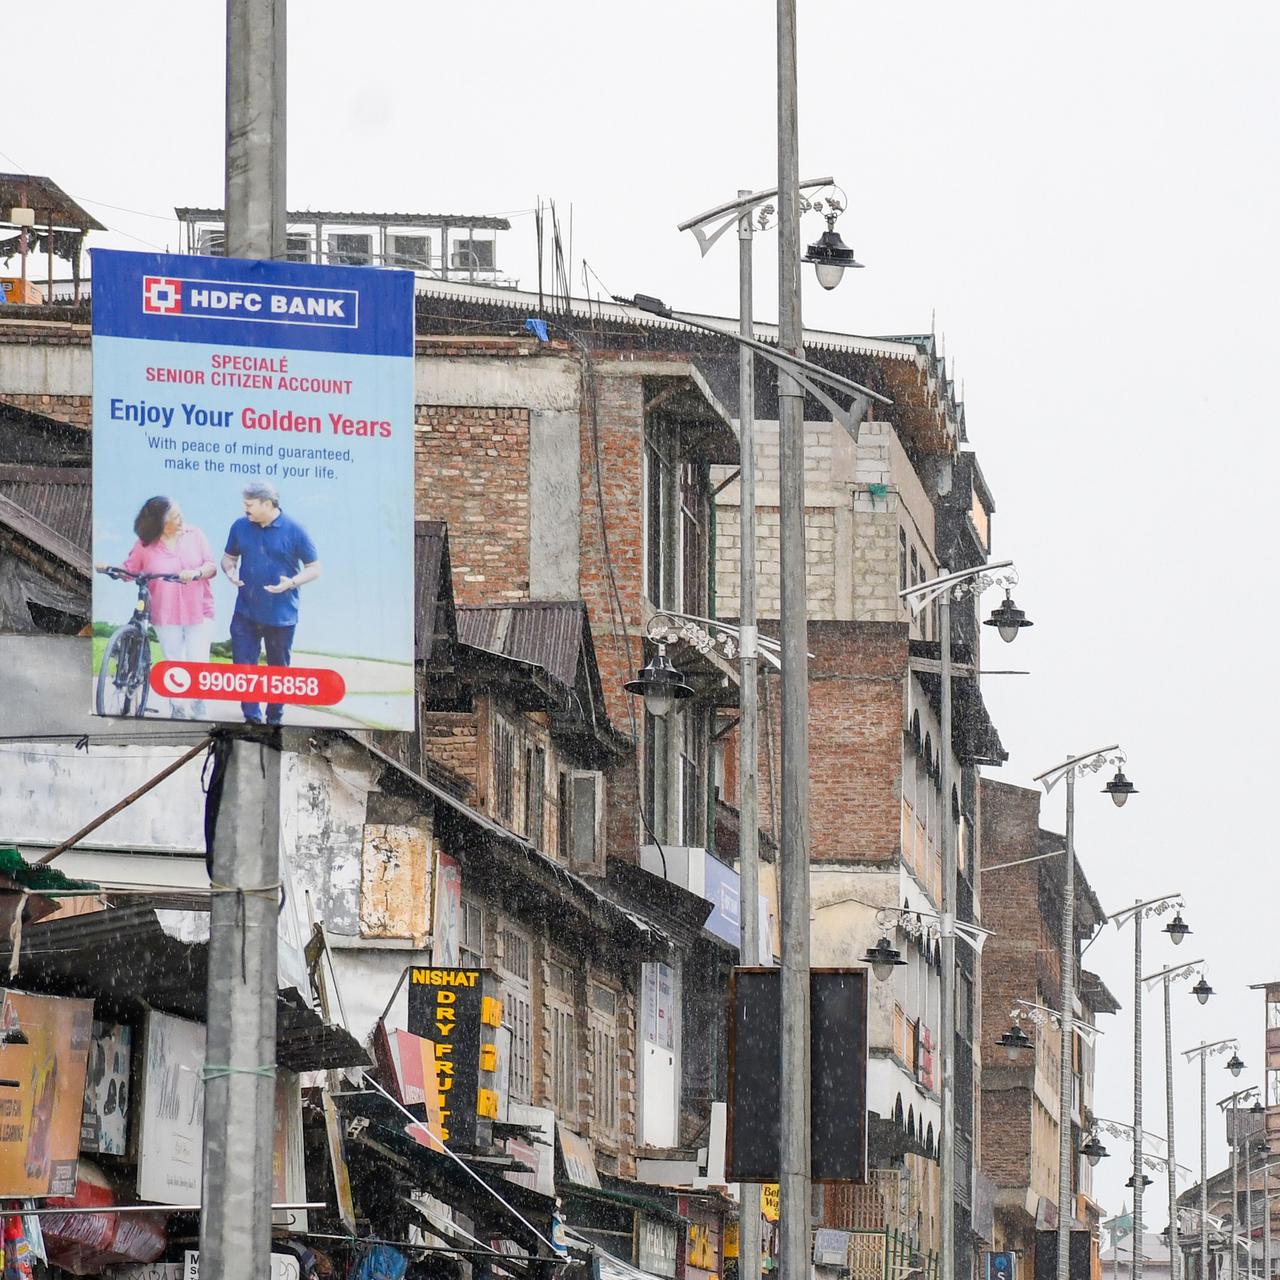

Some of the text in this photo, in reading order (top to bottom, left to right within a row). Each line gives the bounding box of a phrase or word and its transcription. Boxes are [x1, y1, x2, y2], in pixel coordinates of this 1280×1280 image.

[191, 289, 345, 318] HDFC BANK
[211, 354, 288, 373] SPECIALÉ
[145, 367, 353, 395] SENIOR CITIZEN ACCOUNT
[110, 398, 392, 438] Enjoy Your Golden Years
[181, 440, 220, 454] peace
[225, 442, 237, 455] of
[242, 443, 274, 457] mind
[278, 446, 354, 464] guaranteed,
[164, 457, 338, 480] make the most of your life.
[198, 671, 319, 698] 9906715858
[412, 969, 480, 987] NISHAT
[435, 990, 457, 1037] DRY
[434, 1043, 456, 1142] FRUITS
